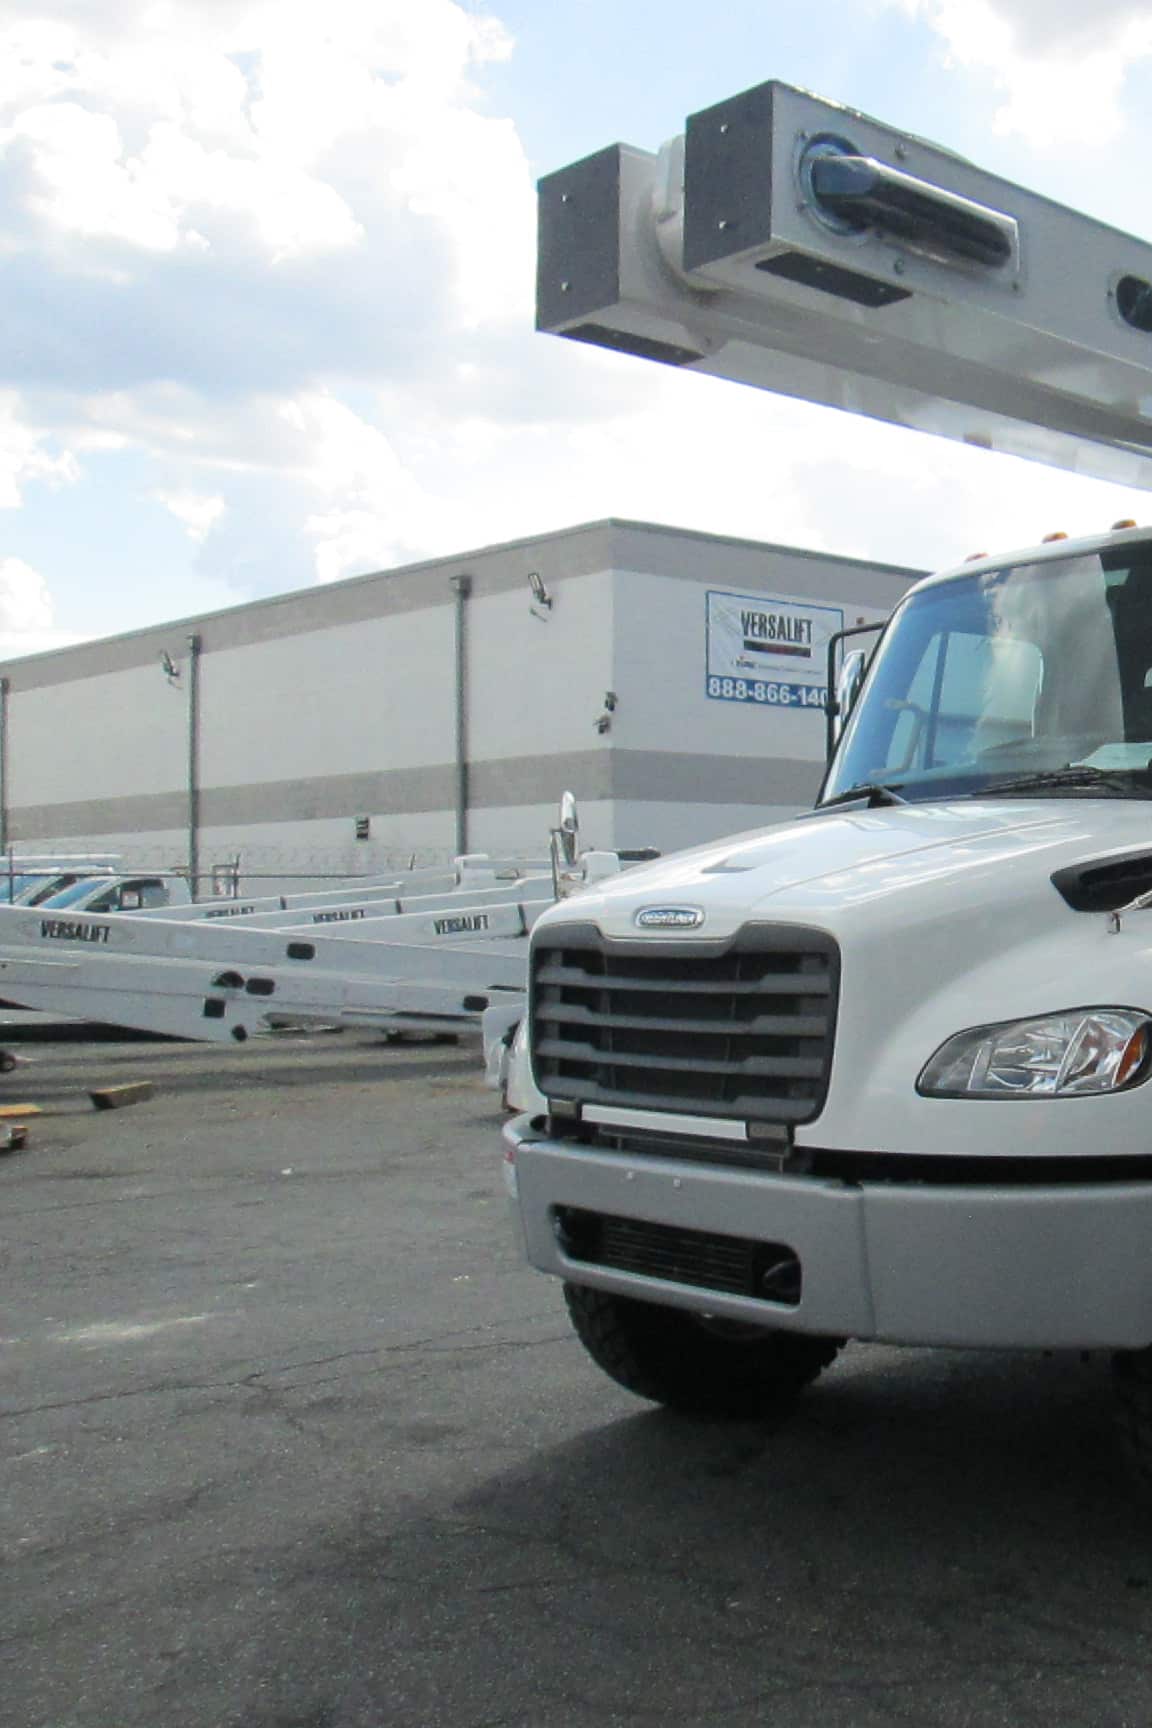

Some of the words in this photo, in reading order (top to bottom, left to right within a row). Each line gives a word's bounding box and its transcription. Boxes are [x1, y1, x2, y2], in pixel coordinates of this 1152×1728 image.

[740, 610, 812, 643] VERSALIFT
[41, 919, 111, 943] VERSALIFT
[433, 914, 488, 934] VERSALIFT
